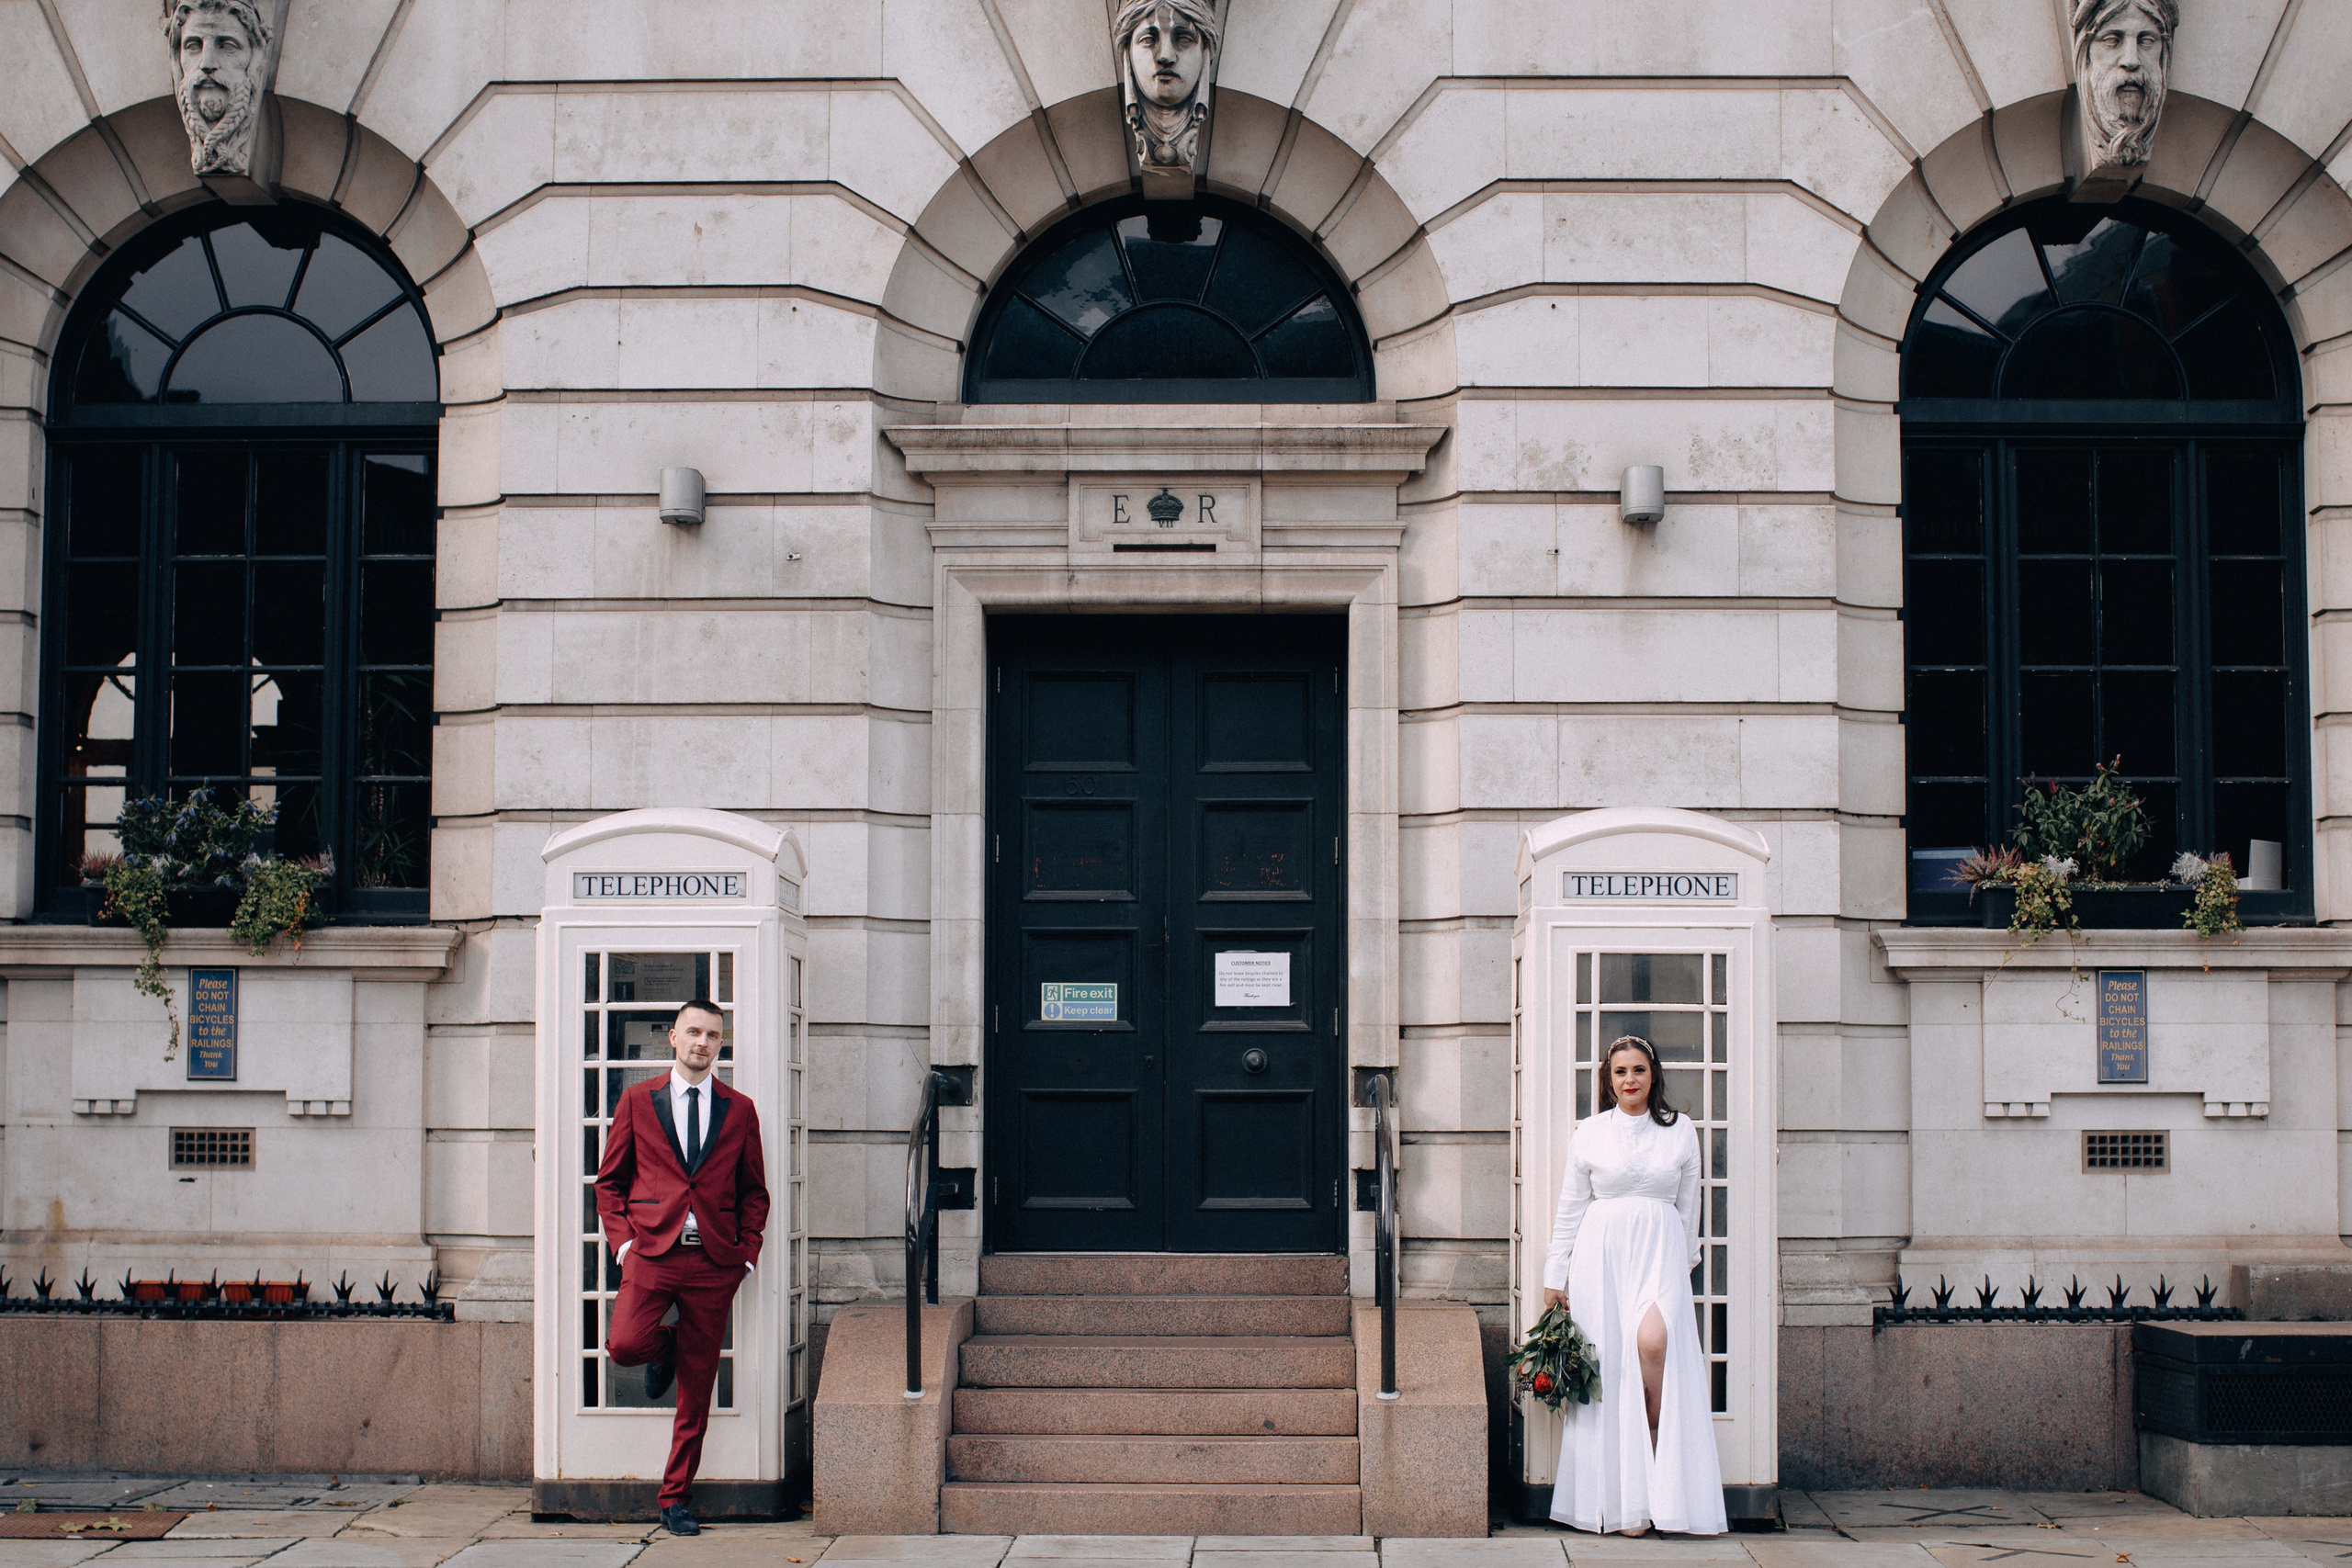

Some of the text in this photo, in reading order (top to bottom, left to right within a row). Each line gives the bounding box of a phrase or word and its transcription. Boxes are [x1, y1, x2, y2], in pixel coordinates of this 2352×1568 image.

[1113, 494, 1217, 524] E R
[582, 875, 739, 896] TELEPHONE
[1571, 875, 1730, 897] TELEPHONE
[198, 978, 228, 989] Please
[2108, 980, 2138, 991] Please
[196, 991, 229, 1000] DO NOT
[1064, 987, 1114, 998] Fire exit
[2105, 993, 2140, 1002] DO NOT
[198, 1003, 226, 1012] CHAIN
[1064, 1006, 1114, 1016] Keep clear
[2108, 1005, 2136, 1014] CHAIN
[189, 1015, 234, 1024] BICYCLES
[2099, 1017, 2146, 1026] BICYCLES
[198, 1026, 226, 1036] to the
[2109, 1028, 2138, 1038] to the
[191, 1039, 232, 1048] RAILINGS
[2102, 1041, 2144, 1050] RAILINGS
[2110, 1053, 2135, 1061] Thank
[204, 1060, 218, 1068] You
[2116, 1062, 2131, 1071] You
